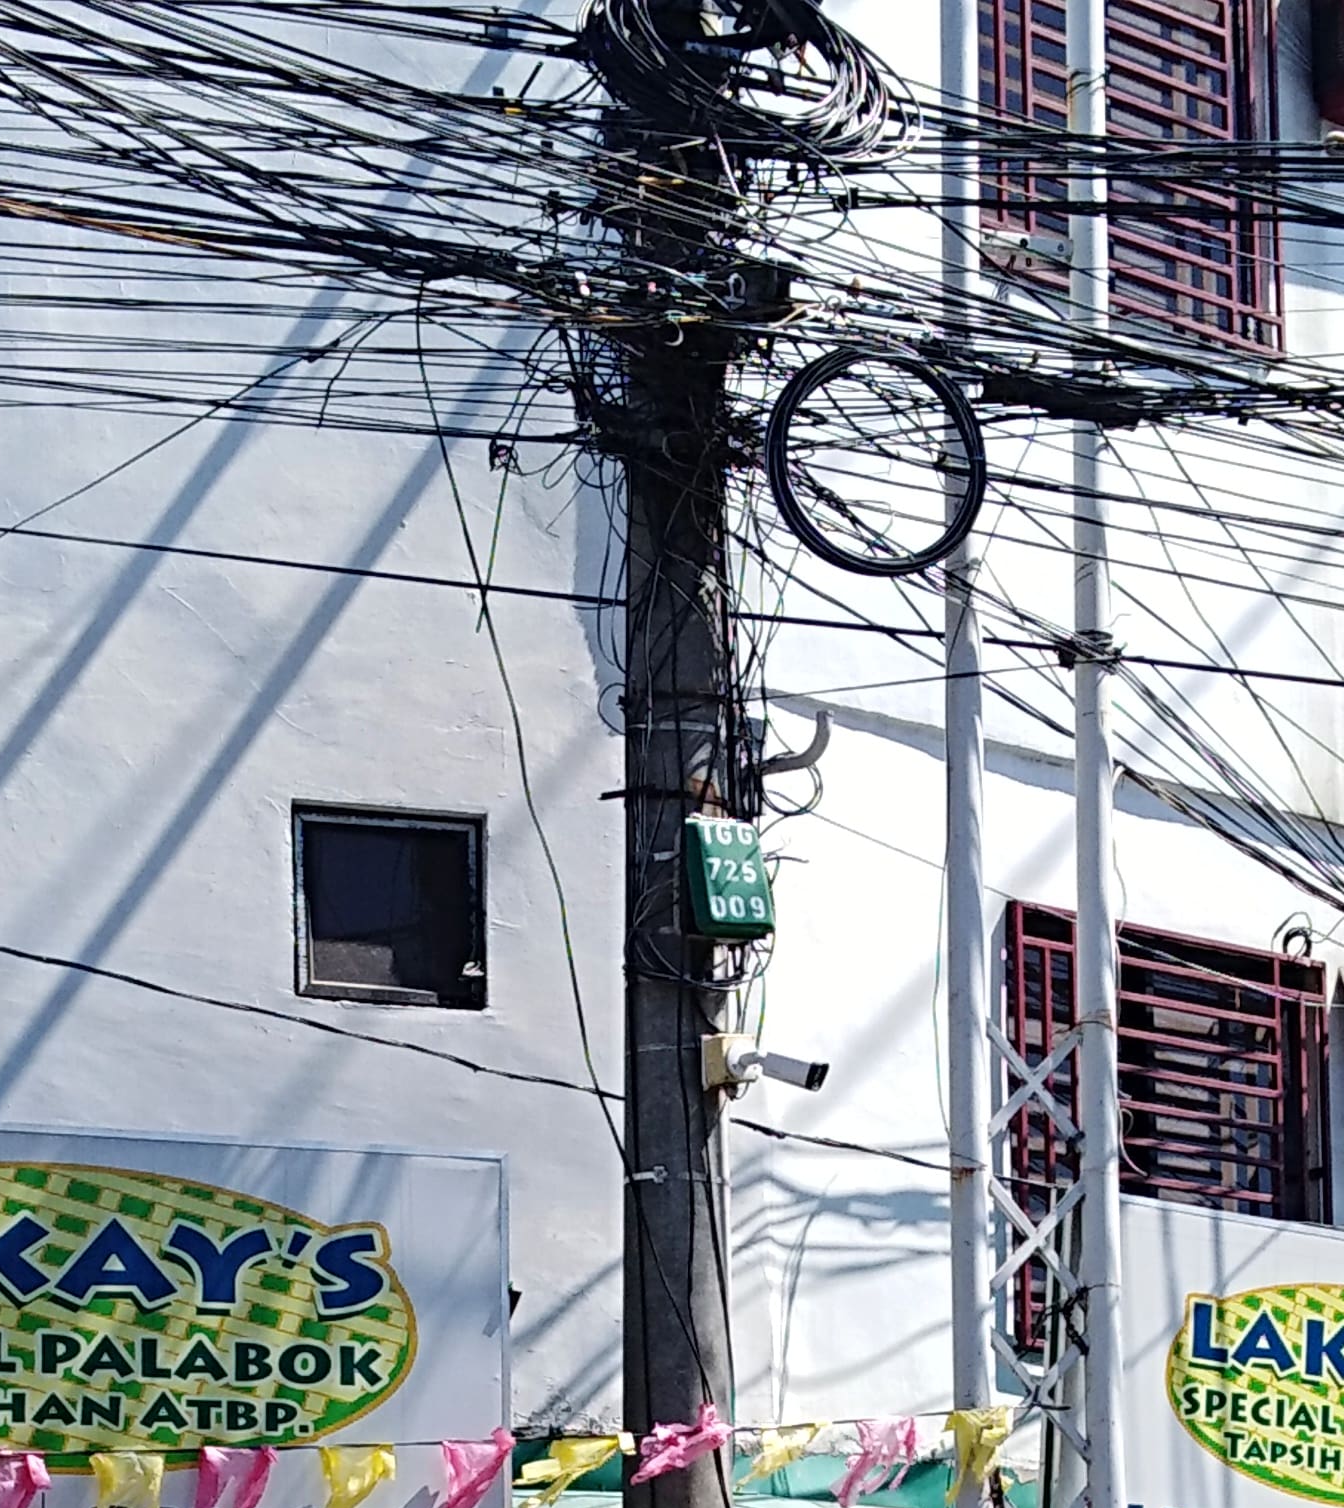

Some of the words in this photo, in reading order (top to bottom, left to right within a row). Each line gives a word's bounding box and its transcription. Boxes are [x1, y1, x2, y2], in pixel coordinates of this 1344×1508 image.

[710, 895, 766, 919] 009
[41, 1330, 386, 1389] PALABOK
[140, 1391, 311, 1435] ATBP.
[1182, 1383, 1338, 1435] SPECIAL
